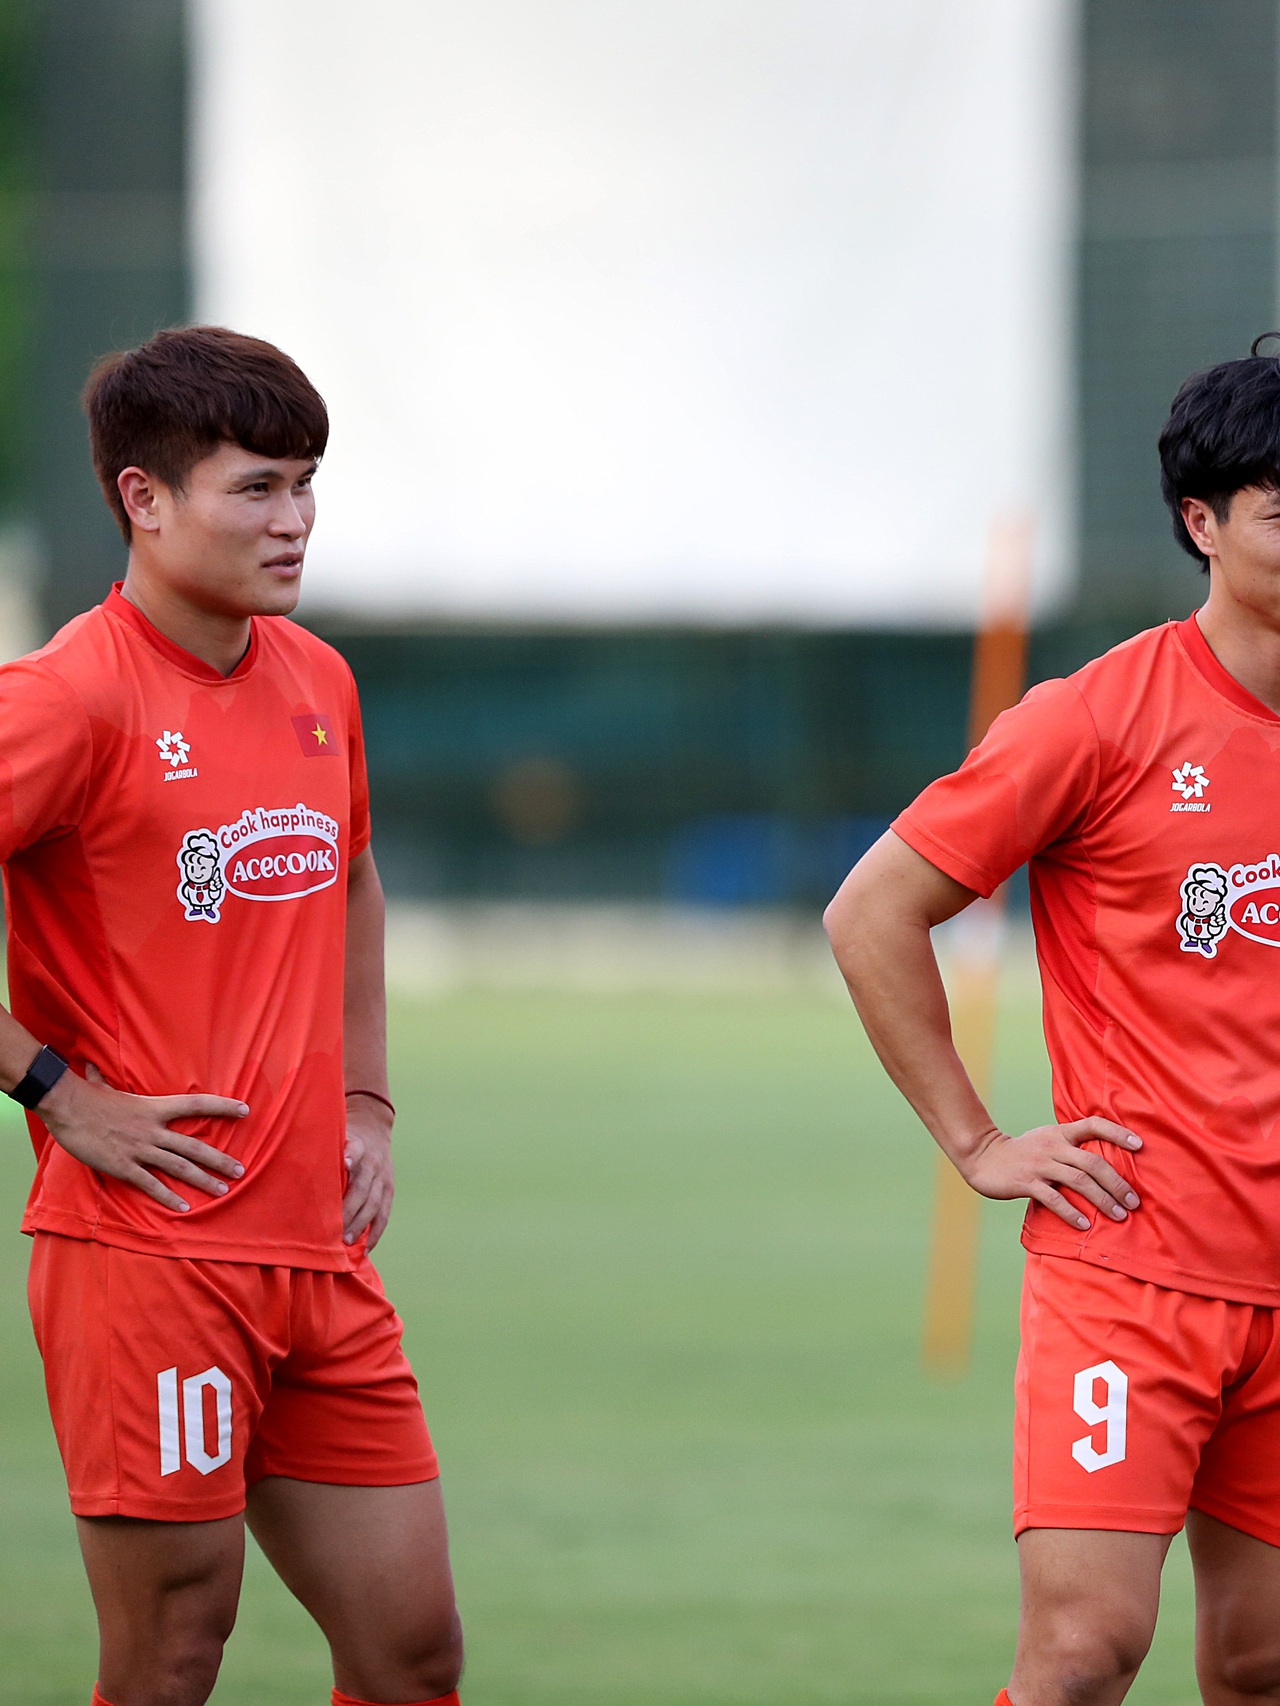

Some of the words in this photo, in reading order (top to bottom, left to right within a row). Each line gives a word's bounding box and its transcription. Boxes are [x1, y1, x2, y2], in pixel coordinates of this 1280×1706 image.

[163, 768, 198, 782] JOGARBOLA
[1170, 803, 1211, 812] JOGARBOLA
[220, 816, 258, 849] Cook
[259, 808, 337, 838] happiness
[157, 1365, 233, 1477] 10
[1071, 1359, 1128, 1474] 9
